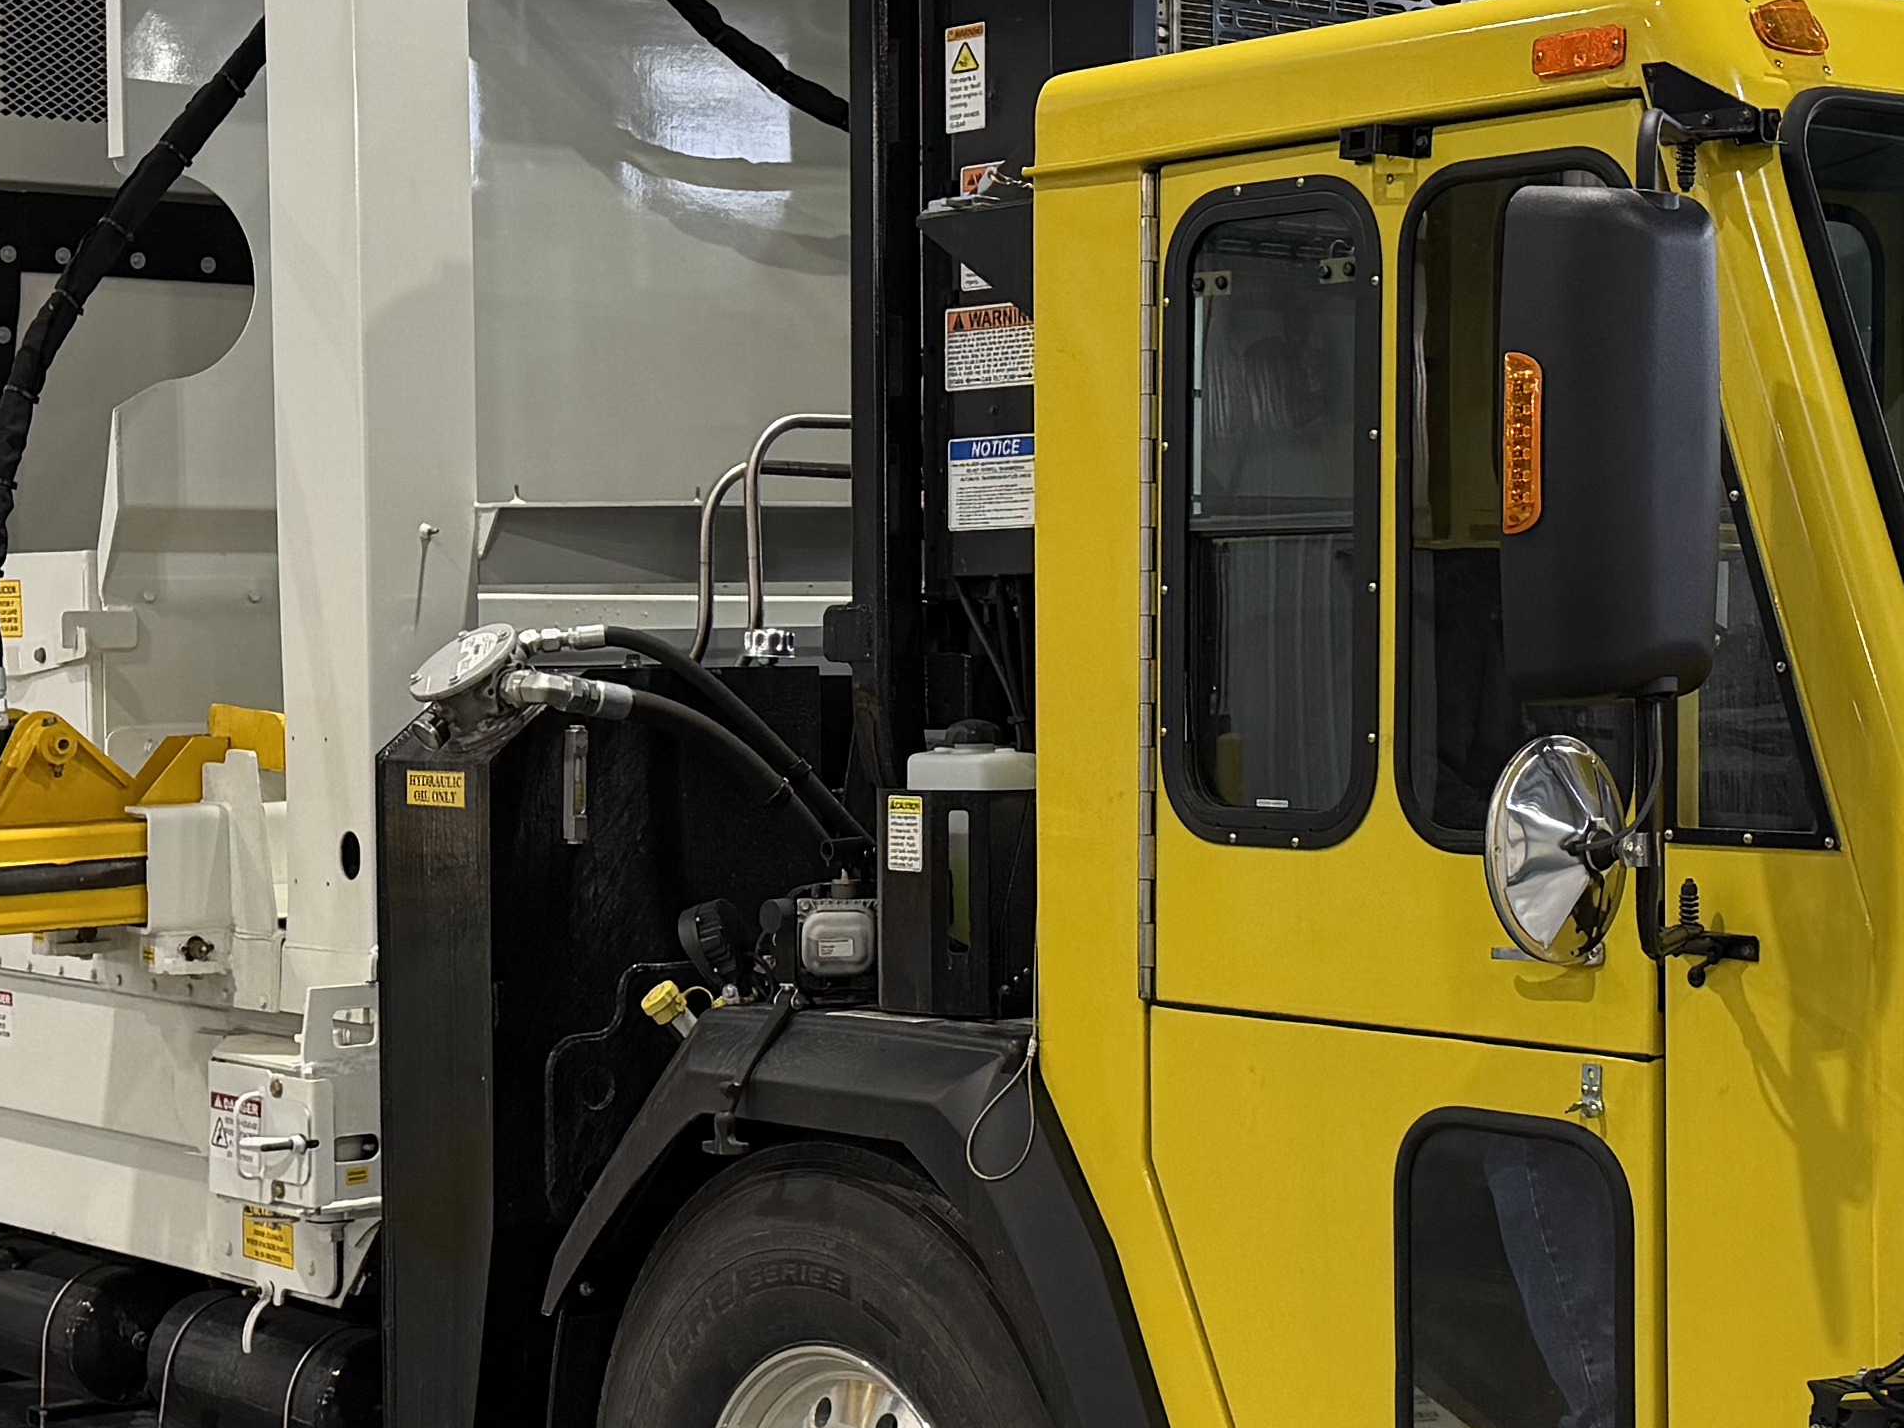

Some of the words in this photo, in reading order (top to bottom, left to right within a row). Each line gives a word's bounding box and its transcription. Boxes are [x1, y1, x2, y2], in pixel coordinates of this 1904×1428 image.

[969, 306, 1034, 328] WARNIN
[971, 439, 1021, 458] NOTICE
[409, 774, 463, 788] HYDRAULIC
[413, 790, 430, 803] OIL
[432, 790, 457, 804] ONLY
[223, 1097, 260, 1116] DAGER
[748, 1260, 846, 1294] SERIES
